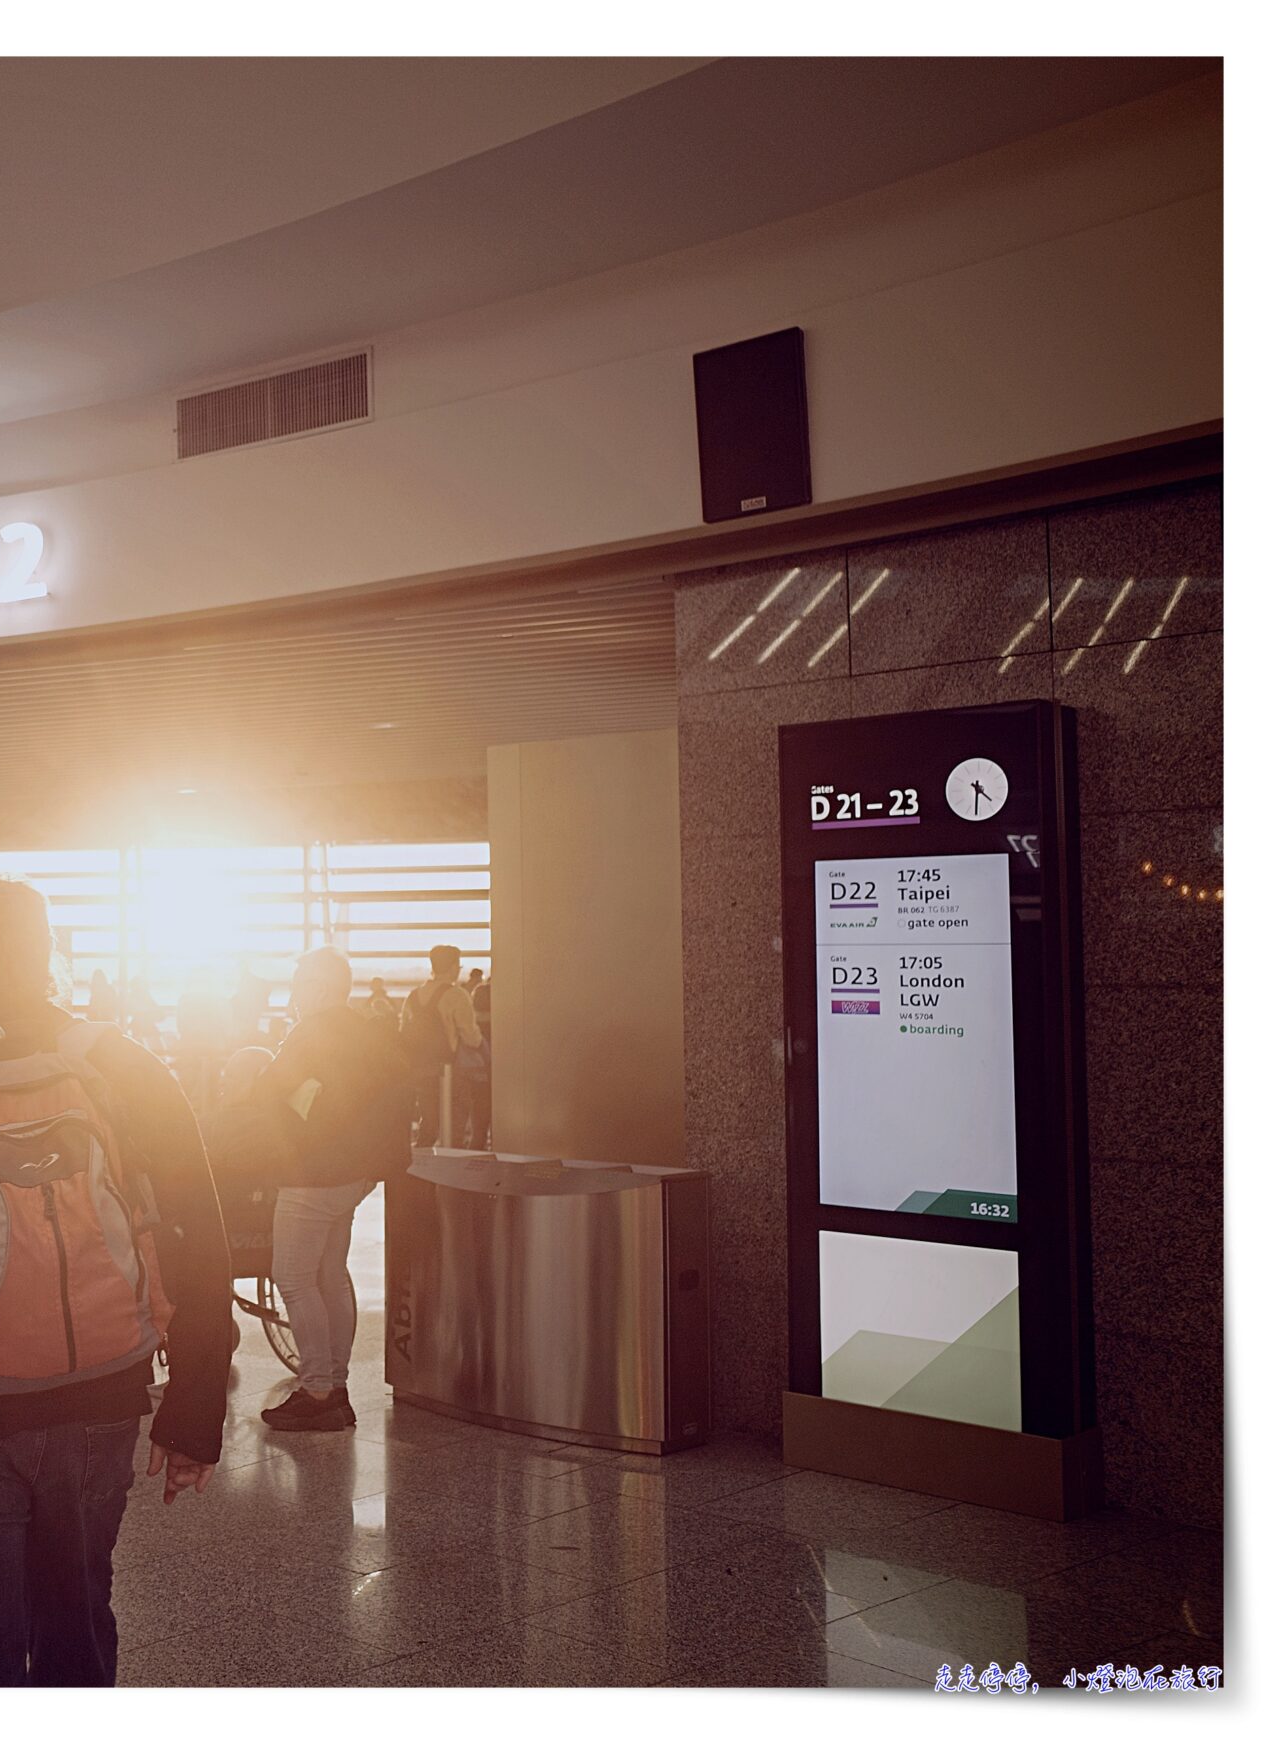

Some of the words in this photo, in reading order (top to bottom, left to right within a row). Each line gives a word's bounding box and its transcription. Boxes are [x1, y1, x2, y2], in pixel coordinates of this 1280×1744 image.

[897, 869, 941, 883] 17:45
[831, 882, 877, 901] D22
[897, 885, 950, 904] Taipei
[911, 906, 925, 914] 062
[908, 918, 935, 929] gate
[938, 918, 969, 929] open
[899, 956, 943, 970] 17:05
[832, 967, 878, 985] D23
[900, 974, 965, 988] London
[900, 994, 939, 1007] LGW
[910, 1024, 964, 1037] boarding
[970, 1202, 1010, 1217] 16:32
